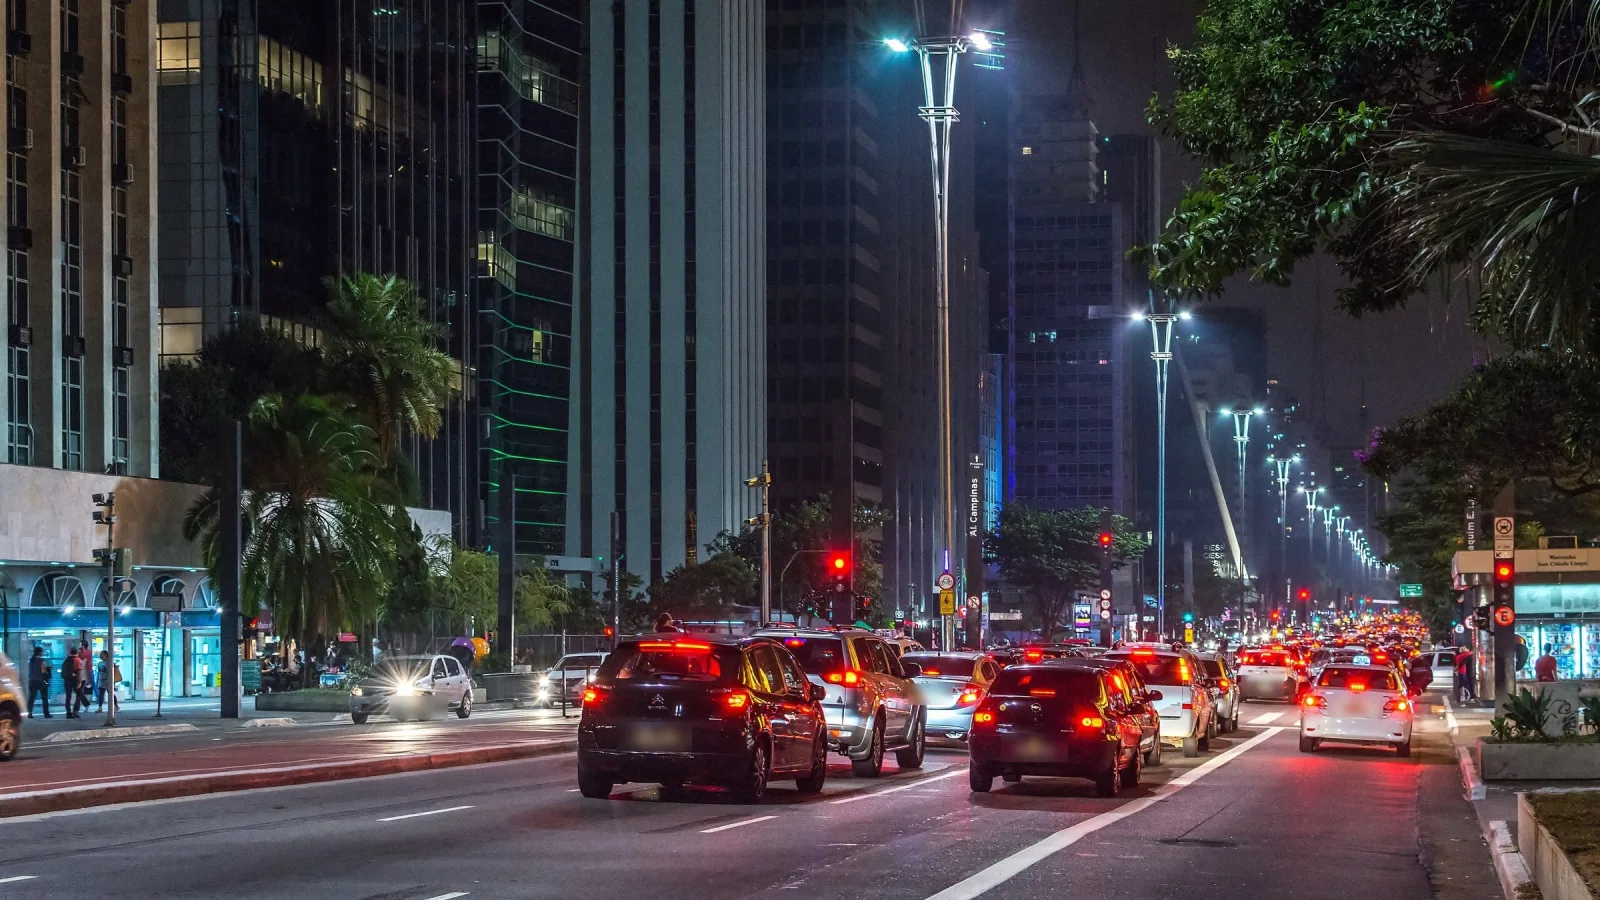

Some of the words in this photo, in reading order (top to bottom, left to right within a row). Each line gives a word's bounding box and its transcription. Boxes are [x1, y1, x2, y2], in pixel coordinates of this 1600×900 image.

[970, 478, 979, 523] Campinas
[1466, 511, 1475, 520] E.
[1466, 522, 1475, 551] aquim
[1501, 610, 1509, 622] E
